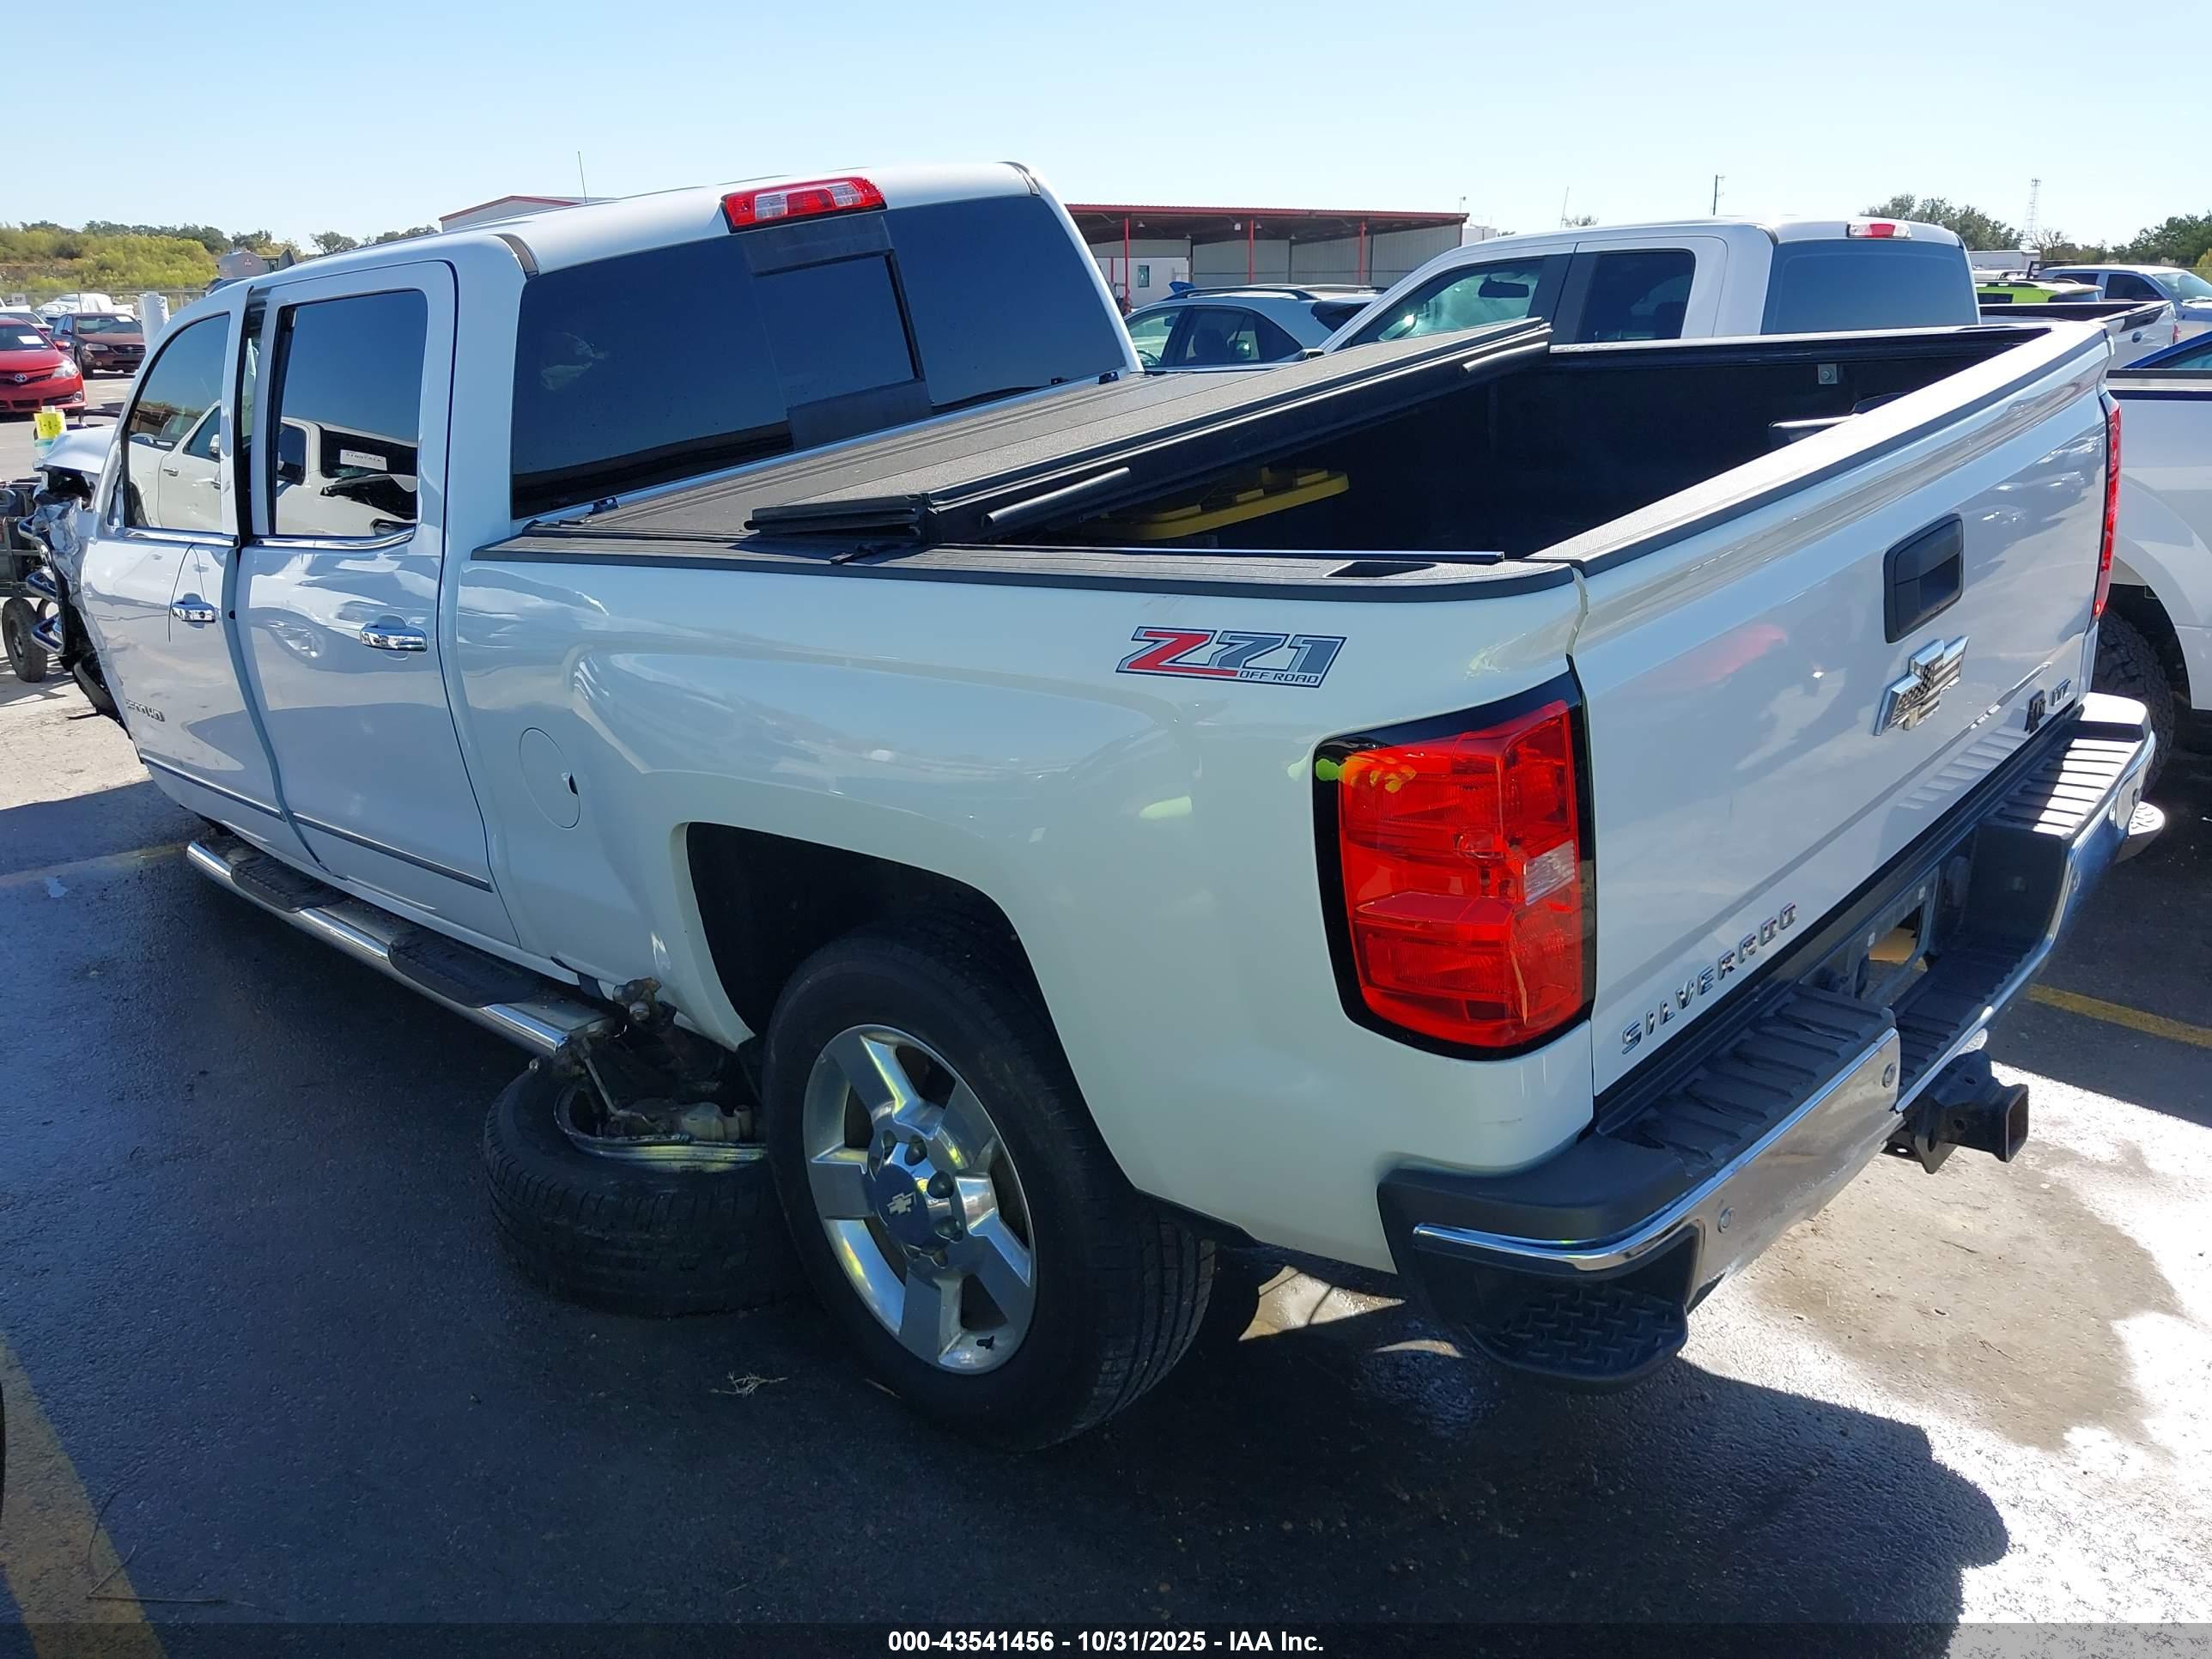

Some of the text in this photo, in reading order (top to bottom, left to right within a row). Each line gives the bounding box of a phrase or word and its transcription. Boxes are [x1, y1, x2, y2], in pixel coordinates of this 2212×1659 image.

[1115, 626, 1347, 688] Z71
[1239, 669, 1319, 684] OFF ROAD
[1621, 902, 1797, 1055] SILVERADO
